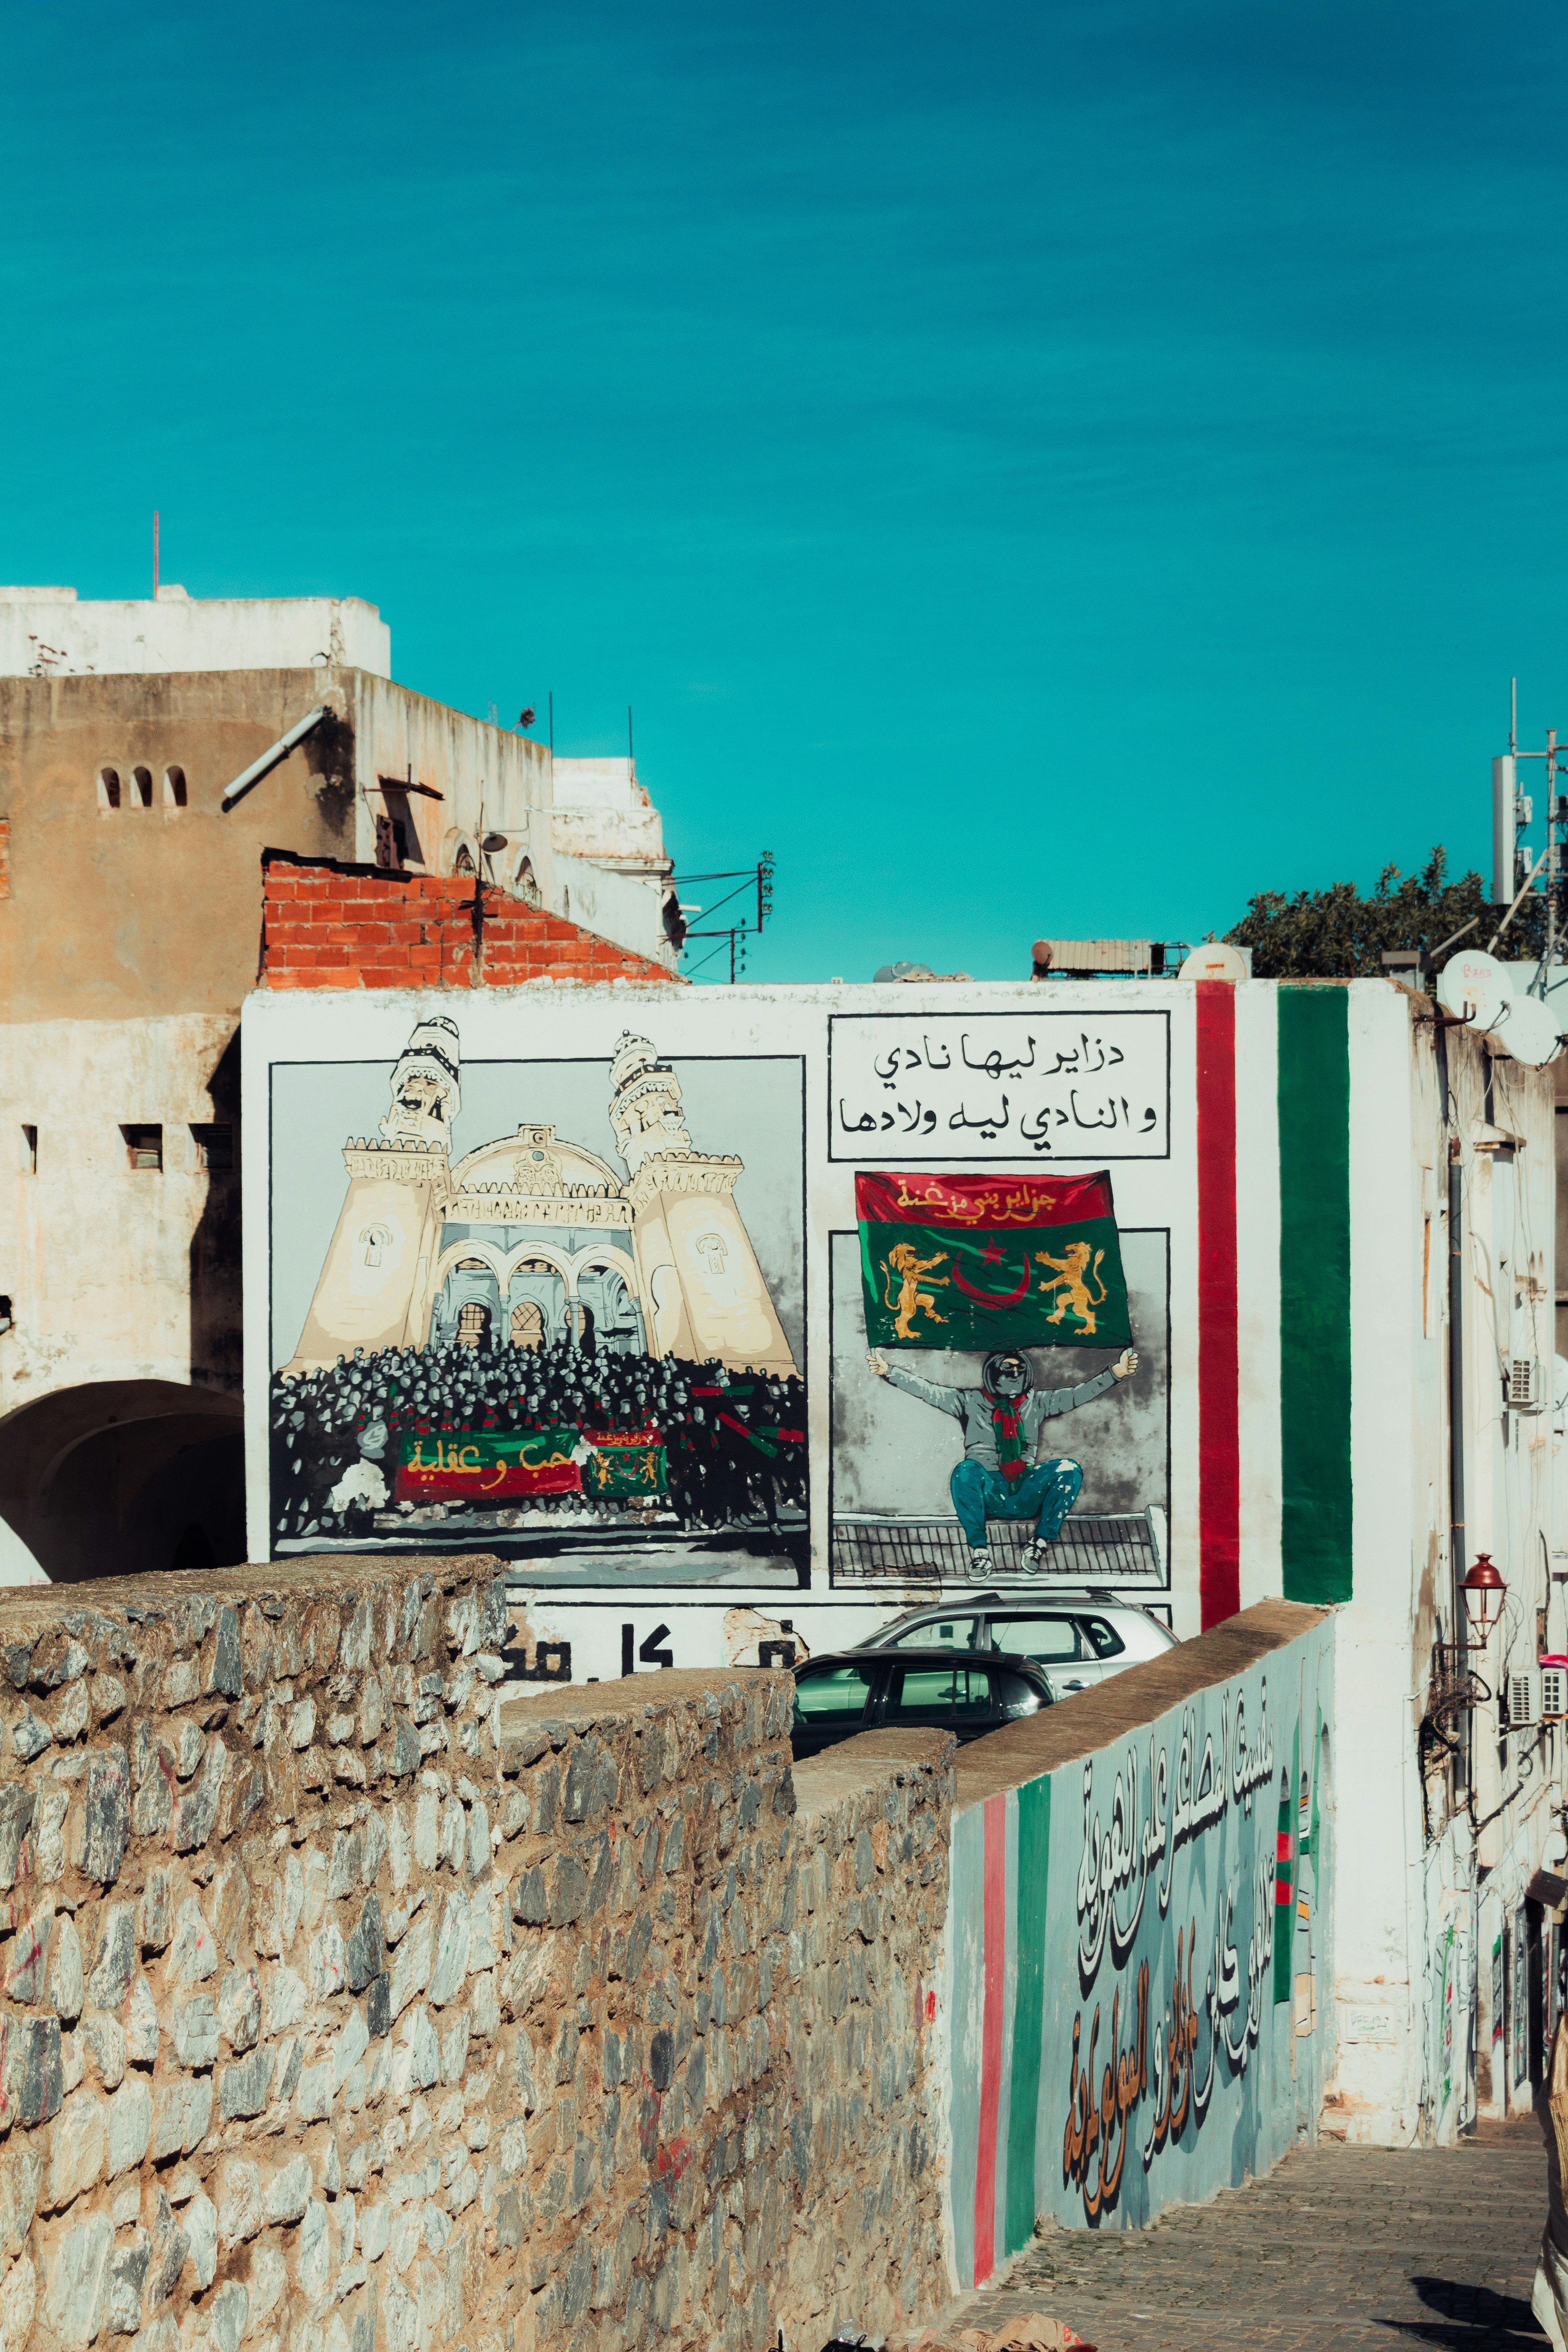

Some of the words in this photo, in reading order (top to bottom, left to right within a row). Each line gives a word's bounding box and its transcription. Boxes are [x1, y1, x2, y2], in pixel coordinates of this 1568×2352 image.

[874, 1035, 951, 1089] نادي
[961, 1034, 1036, 1079] ليها
[1038, 1033, 1124, 1076] دزاير
[840, 1098, 937, 1135] ولادها
[949, 1093, 1009, 1139] ليه
[897, 1179, 967, 1212] مزغنة
[934, 1192, 999, 1225] بني
[991, 1184, 1057, 1222] جزاير
[407, 1440, 482, 1481] عقلية
[481, 1459, 508, 1490] و
[519, 1443, 572, 1478] حب
[1112, 1733, 1167, 1970] على
[1077, 1759, 1138, 2002] الهوية
[1063, 1956, 1148, 2229] المولودية
